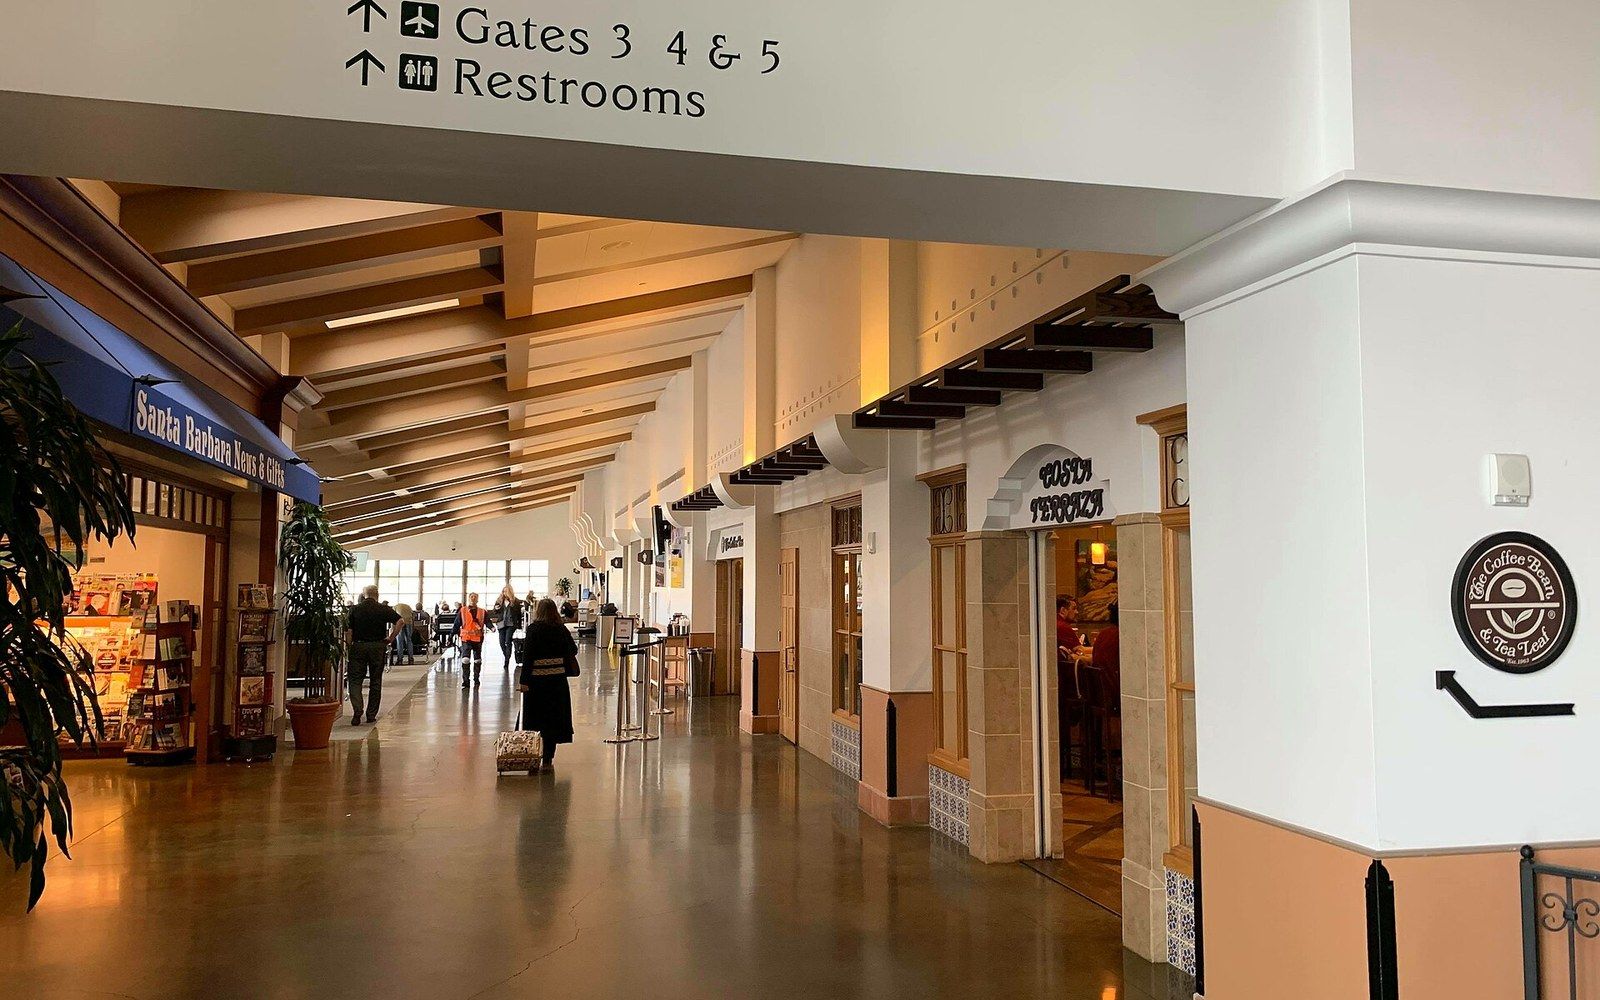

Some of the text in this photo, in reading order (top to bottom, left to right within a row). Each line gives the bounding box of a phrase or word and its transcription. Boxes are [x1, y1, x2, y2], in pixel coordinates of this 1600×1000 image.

[455, 7, 780, 73] Gates 3 4 & 5
[453, 58, 705, 117] Restrooms
[136, 389, 285, 489] Santa Barbara News & Gifts
[1038, 456, 1093, 488] COSTA
[1030, 488, 1104, 523] TERRAZA
[1468, 549, 1556, 601] The Coffee Bean
[1479, 626, 1551, 657] & Tea Leaf
